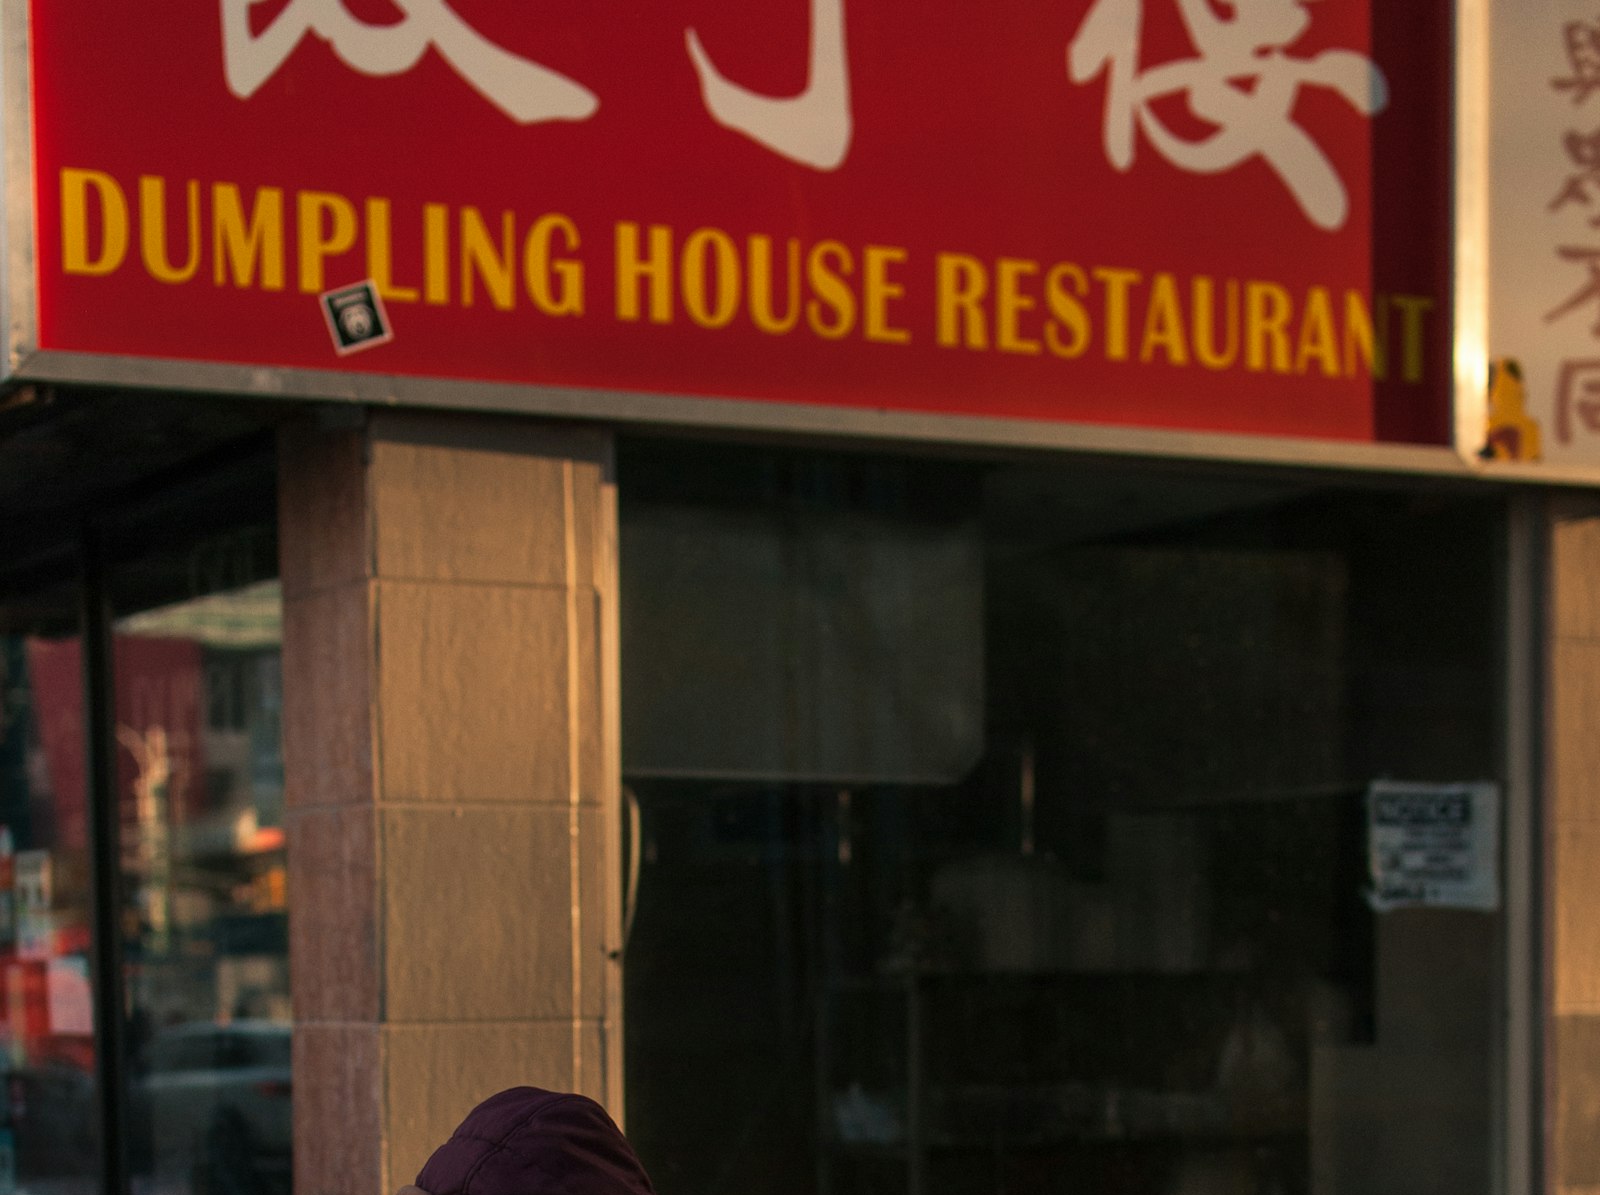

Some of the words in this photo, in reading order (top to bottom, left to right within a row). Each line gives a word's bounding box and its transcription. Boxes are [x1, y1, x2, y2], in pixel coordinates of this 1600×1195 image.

[60, 166, 584, 317] DUMPLING
[614, 220, 911, 344] HOUSE
[936, 252, 1431, 383] RESTAURANT
